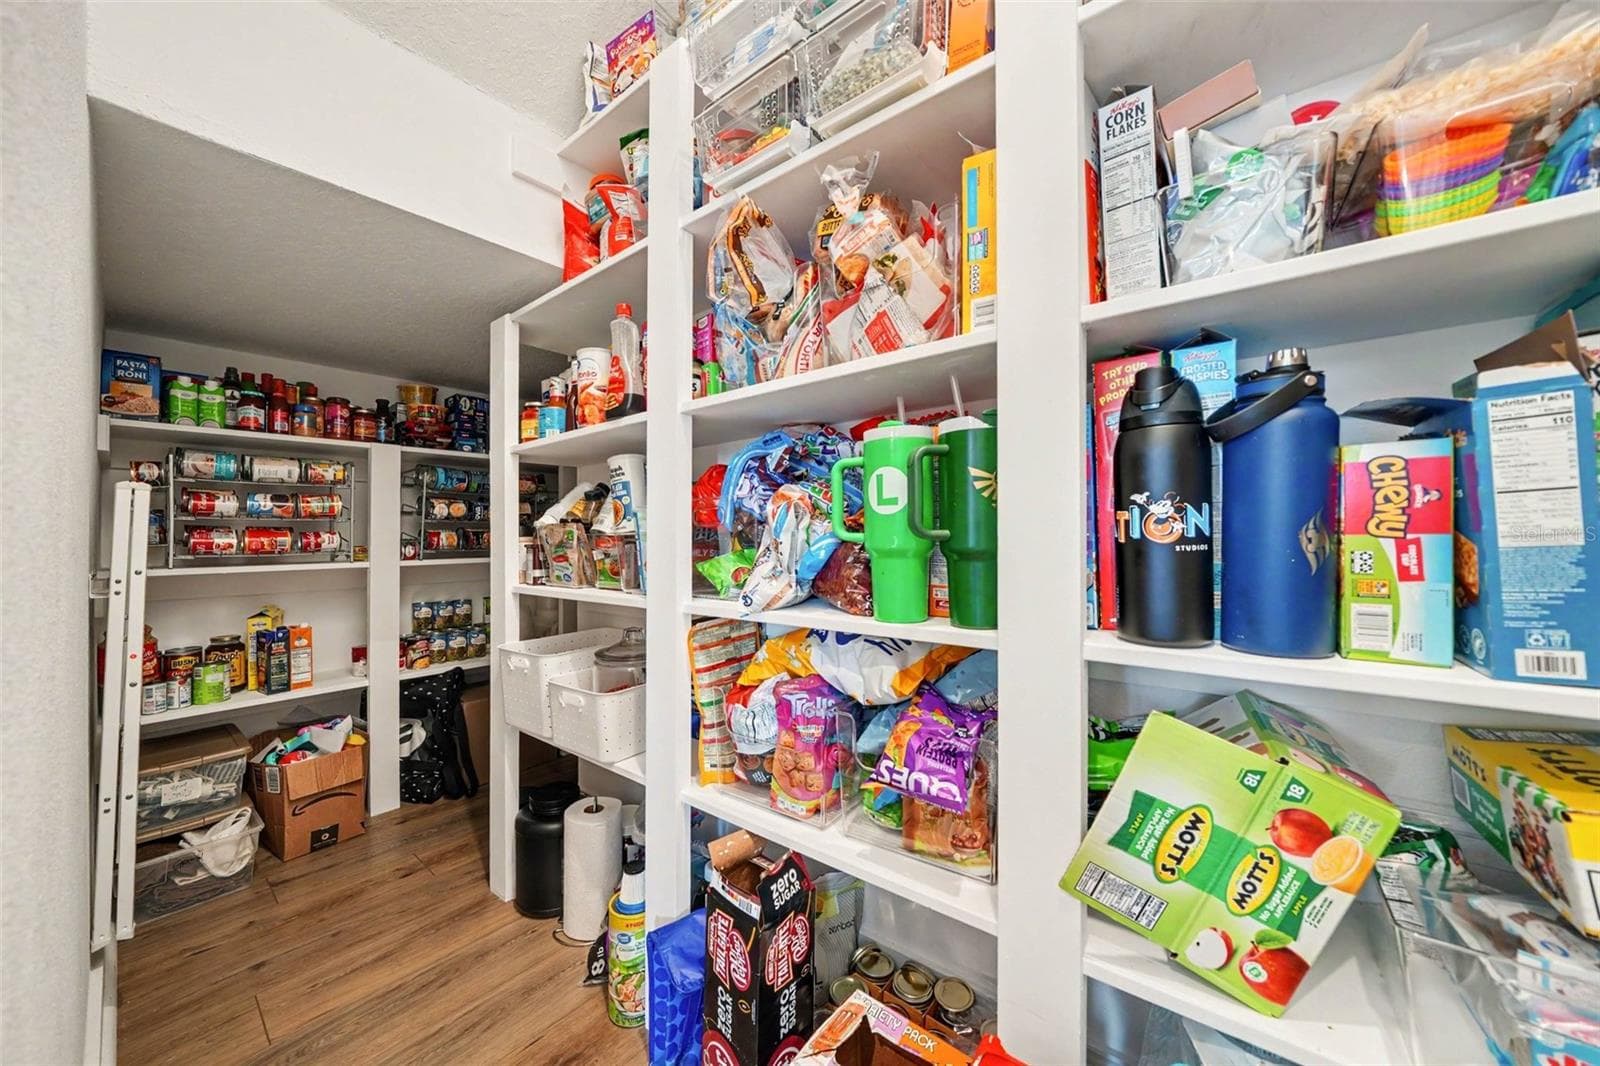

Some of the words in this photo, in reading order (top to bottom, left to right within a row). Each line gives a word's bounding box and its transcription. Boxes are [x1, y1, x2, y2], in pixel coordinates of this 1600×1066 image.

[1105, 101, 1145, 128] CORN
[1106, 115, 1147, 141] FLAKES
[116, 359, 147, 370] PASTA
[800, 339, 817, 374] TORTI
[1181, 361, 1226, 375] FROSTED
[117, 369, 147, 380] RONI
[1102, 366, 1122, 380] TRY
[1109, 374, 1136, 390] OTHE
[1098, 390, 1128, 406] PROD
[1490, 397, 1538, 408] Nutrition
[1541, 393, 1572, 402] Facts
[1553, 416, 1574, 425] 110
[876, 473, 899, 507] L
[1114, 503, 1210, 544] TION
[1175, 544, 1208, 552] STUDIOS
[869, 759, 963, 804] QUES
[1243, 772, 1262, 788] 18
[1286, 783, 1306, 799] 18
[1128, 812, 1144, 834] APPLE
[1154, 816, 1169, 837] Sugar
[1141, 836, 1160, 860] Added
[770, 868, 797, 899] zero
[1279, 866, 1297, 891] Added
[773, 880, 801, 910] SUGAR
[1291, 895, 1308, 916] APPLE
[715, 915, 729, 979] TAILGATE
[778, 920, 790, 985] TAILGATE
[591, 958, 605, 977] 8
[717, 985, 726, 1029] zero
[721, 993, 733, 1042] SUGAR
[780, 988, 789, 1040] zero
[863, 1000, 903, 1030] ARIETY
[903, 1027, 937, 1053] PACK
